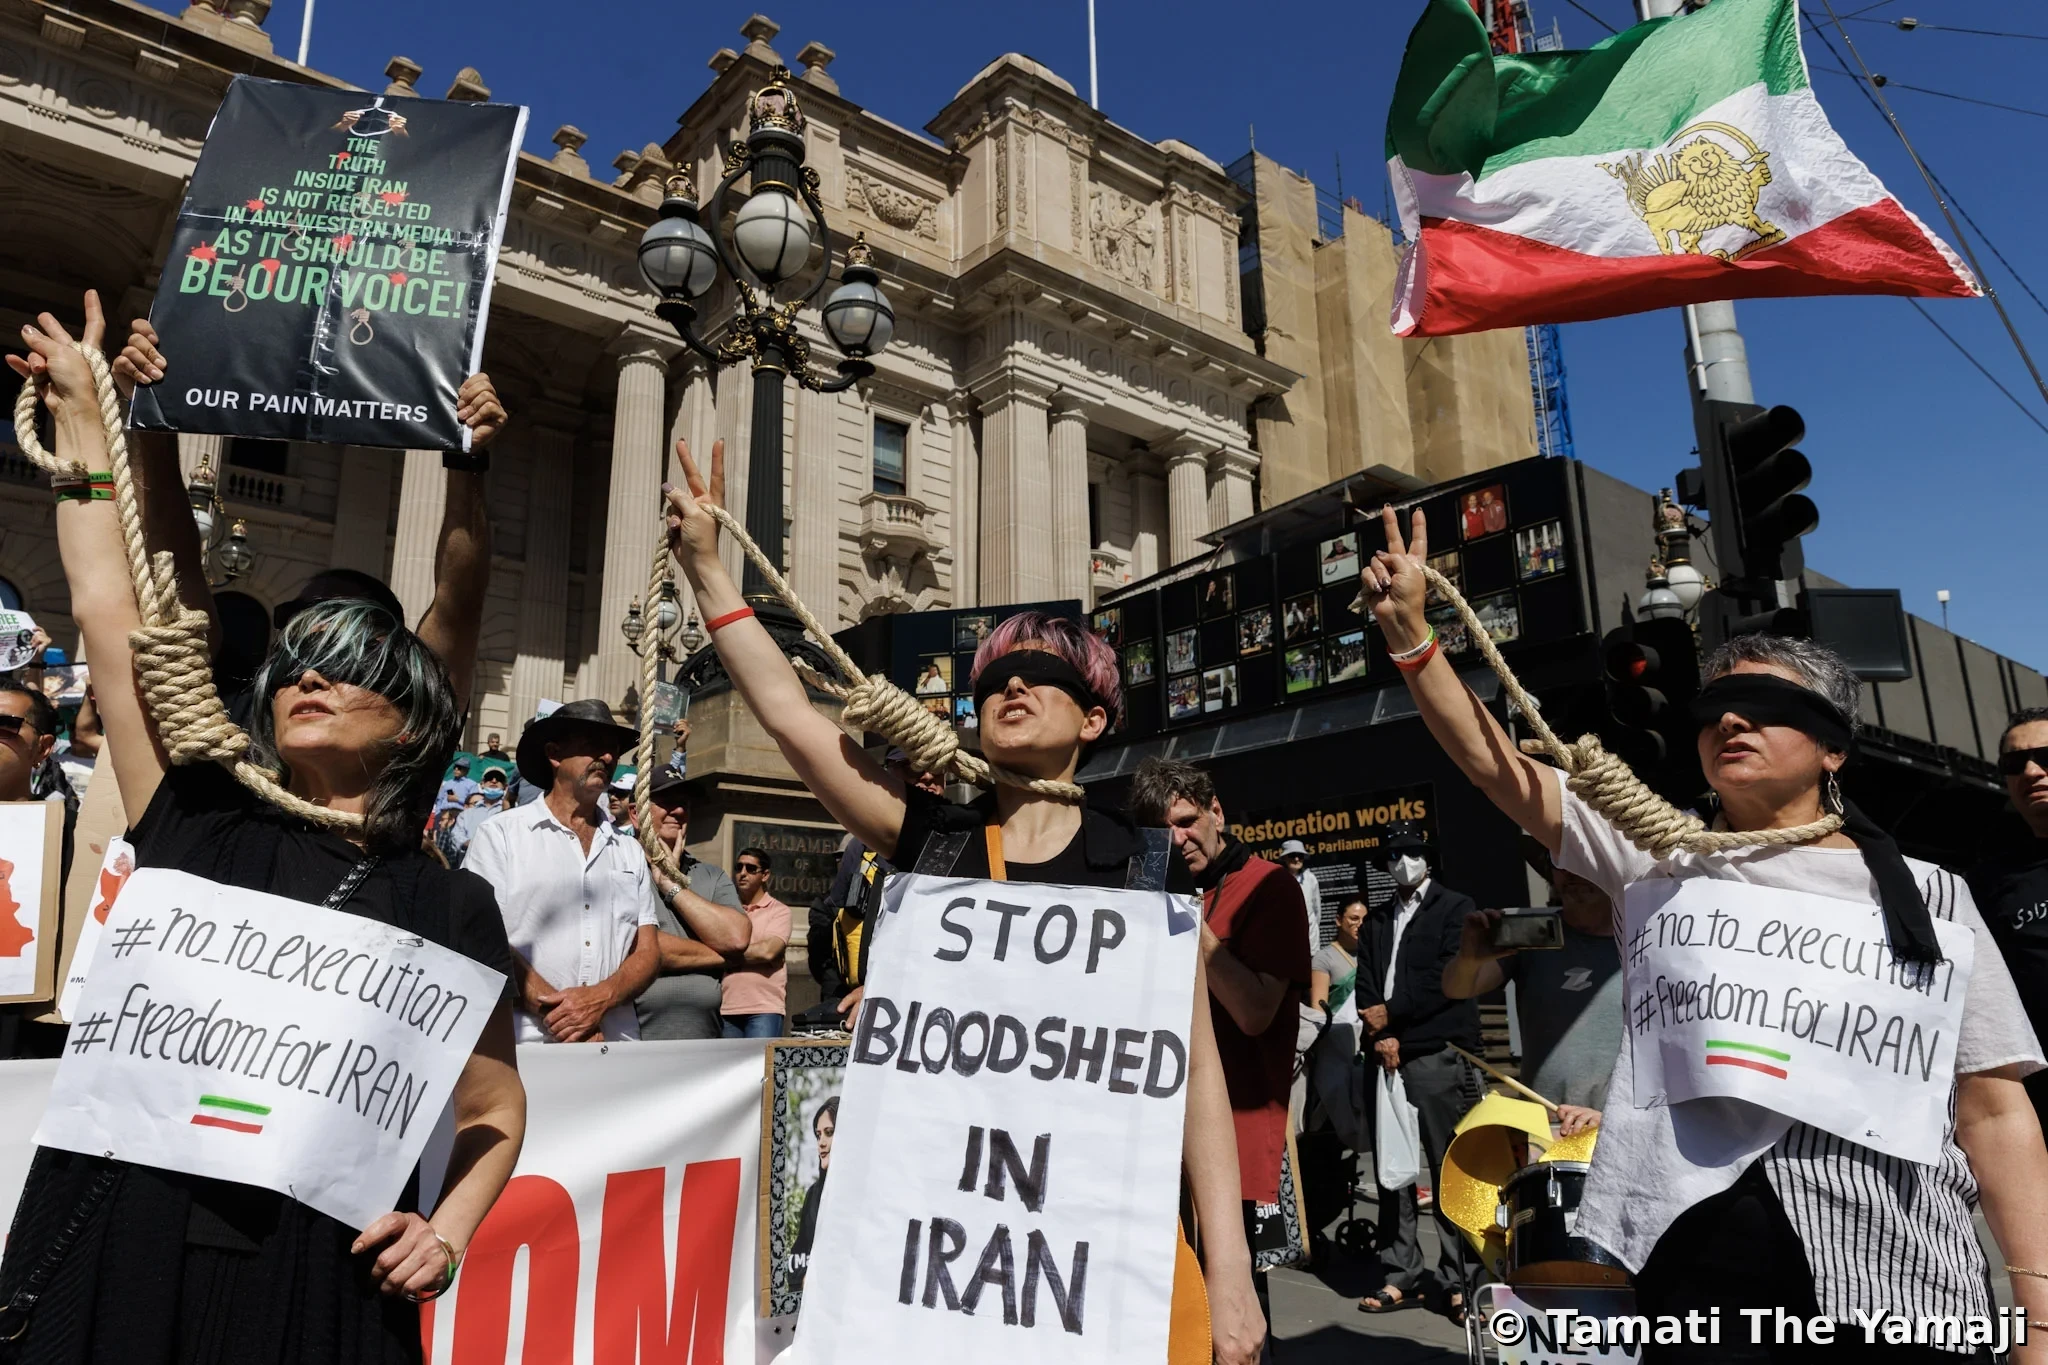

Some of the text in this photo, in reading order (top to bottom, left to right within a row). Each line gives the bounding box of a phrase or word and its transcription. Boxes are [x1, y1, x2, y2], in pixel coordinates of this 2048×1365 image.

[346, 138, 380, 155] THE
[329, 154, 386, 175] TRUTH
[294, 170, 408, 195] INSIDE IRAN
[259, 187, 431, 221] IS NOT REFLECTED
[224, 205, 453, 246] IN ANY WESTERN MEDIA
[213, 227, 451, 276] AS IT SHOULD BE.
[180, 256, 466, 319] BE OUR VOICE!
[185, 388, 429, 423] OUR PAIN MATTERS
[1230, 797, 1427, 844] Restoration works
[748, 831, 841, 854] PARLIAMEN
[1318, 836, 1380, 854] Parliamen
[794, 858, 810, 870] OF
[933, 897, 1126, 974] STOP
[852, 997, 1187, 1098] BLOODSHED
[958, 1125, 1051, 1213] IN
[1255, 1203, 1281, 1219] ajik
[898, 1217, 1090, 1336] IRAN
